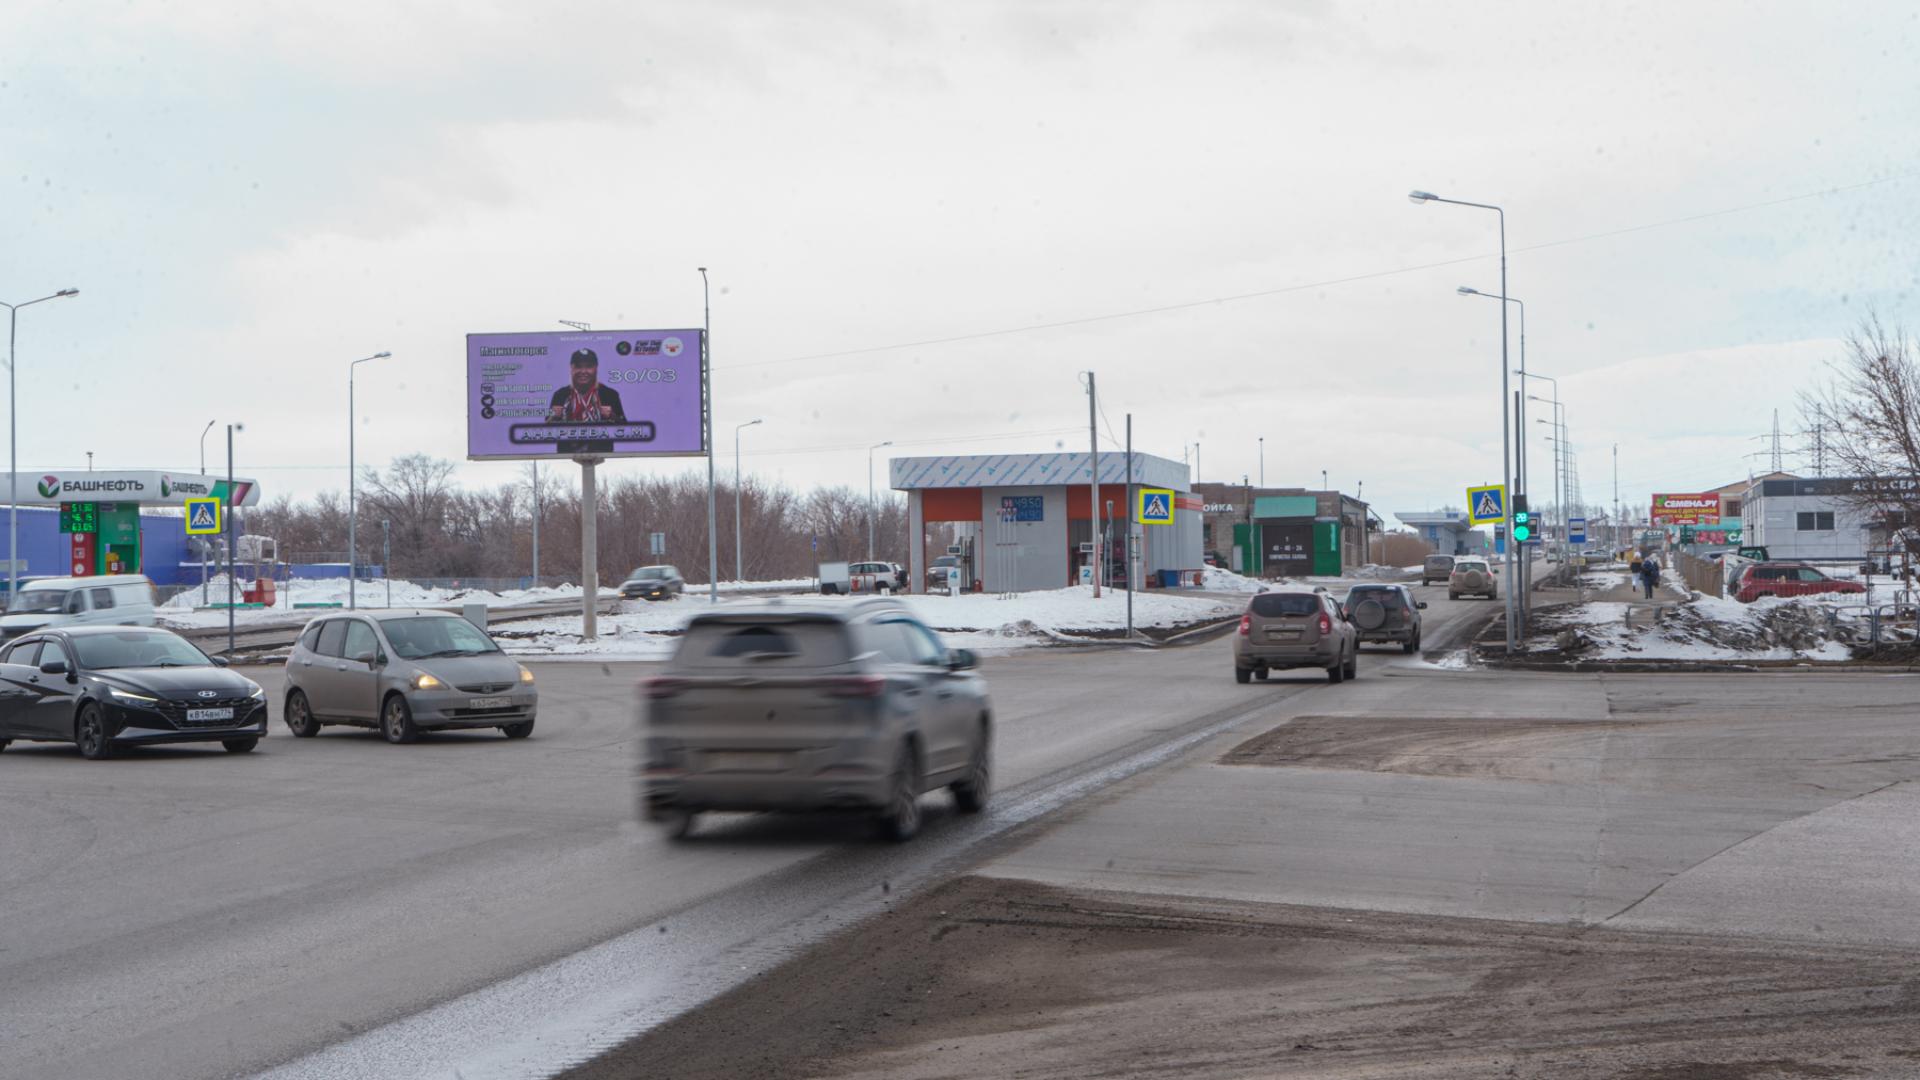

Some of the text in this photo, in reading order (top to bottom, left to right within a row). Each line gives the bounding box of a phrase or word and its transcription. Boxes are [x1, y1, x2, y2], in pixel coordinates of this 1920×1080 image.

[608, 369, 677, 383] 30/03
[63, 480, 144, 492] БАШНЕФТЬ
[172, 481, 208, 494] БАШНЕФТЬ
[1203, 502, 1233, 513] ОЙКА
[950, 571, 958, 579] 4
[1083, 569, 1090, 577] 2
